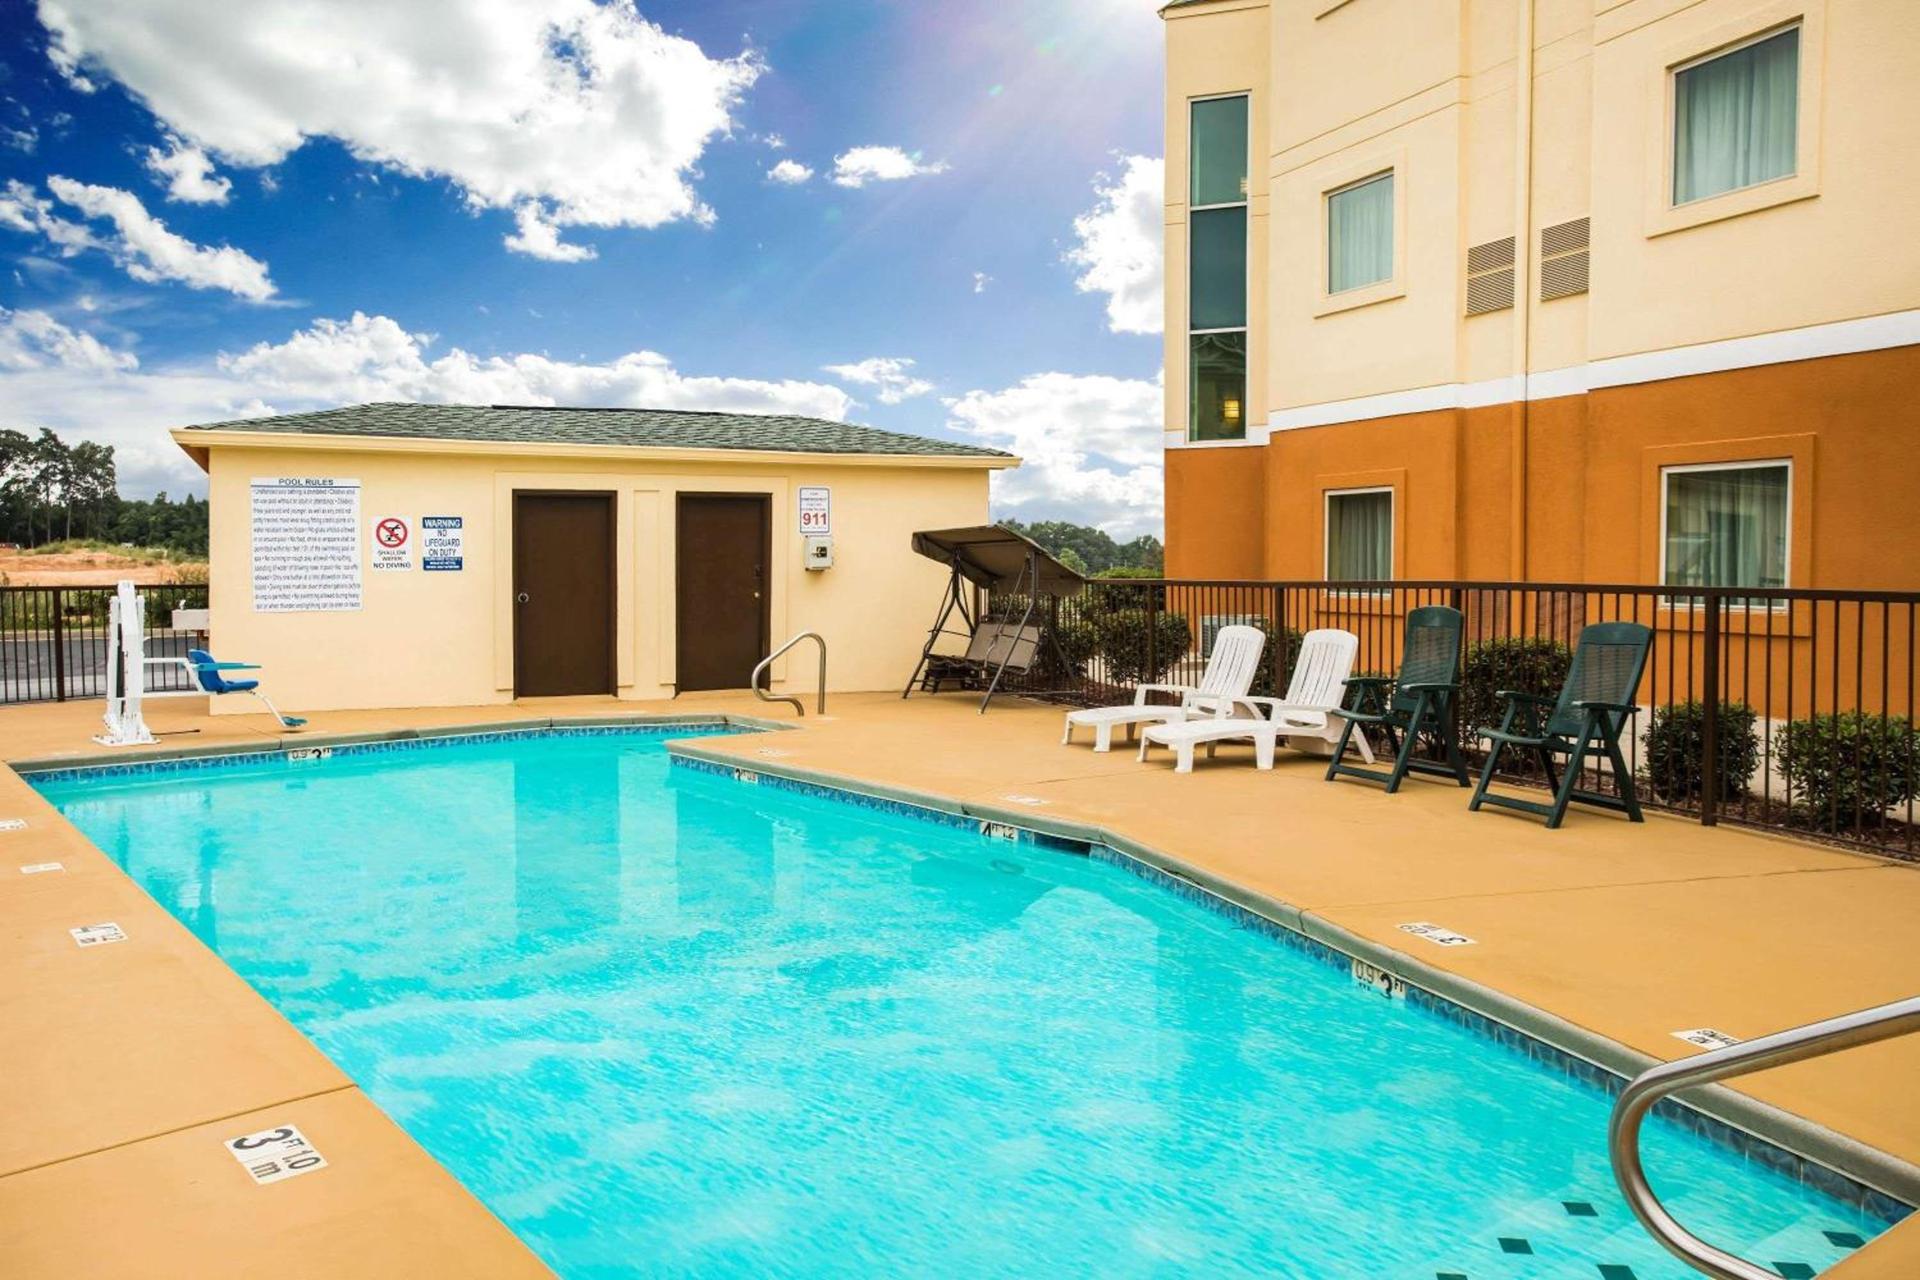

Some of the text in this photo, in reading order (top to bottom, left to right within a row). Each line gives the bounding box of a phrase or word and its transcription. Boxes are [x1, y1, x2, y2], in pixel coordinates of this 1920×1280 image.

[278, 478, 303, 486] POOL
[424, 519, 461, 528] WARNING
[803, 512, 827, 526] 911
[424, 538, 461, 547] LIFEGUARD
[429, 548, 457, 557] ON DUTY
[386, 561, 411, 569] DIVING
[232, 1128, 294, 1150] 3
